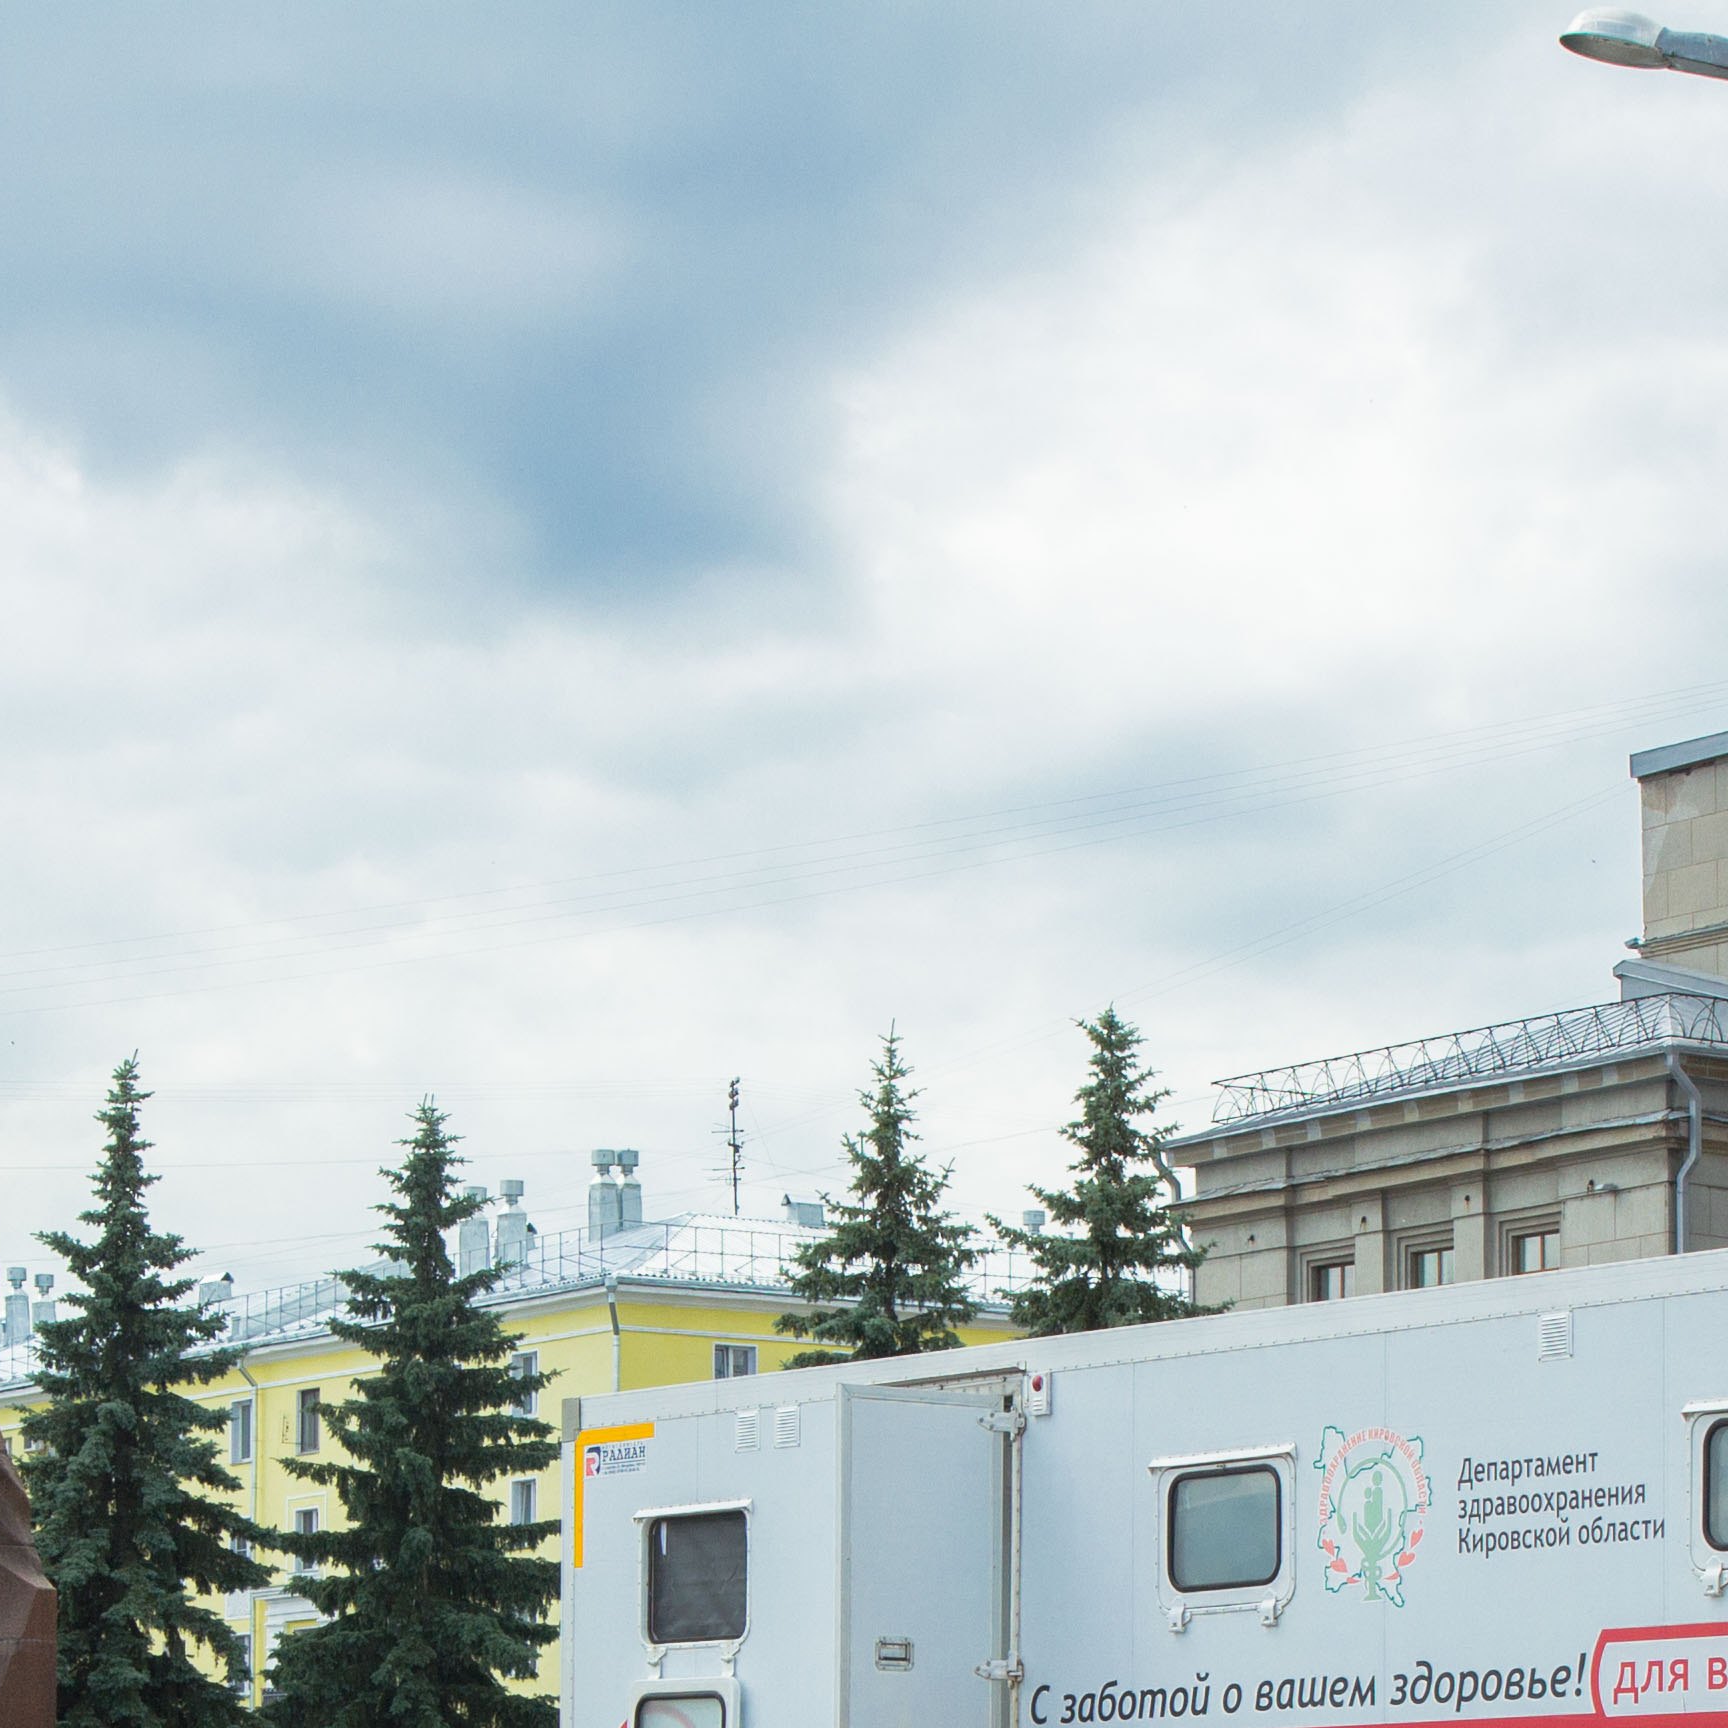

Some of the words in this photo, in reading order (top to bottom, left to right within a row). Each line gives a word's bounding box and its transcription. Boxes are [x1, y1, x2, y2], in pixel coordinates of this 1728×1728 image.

[1457, 1451, 1599, 1491] Департамент
[1458, 1483, 1646, 1524] здравоохранения
[1458, 1517, 1570, 1559] Кировской
[1578, 1515, 1665, 1545] области
[1030, 1684, 1051, 1724] С
[1061, 1672, 1210, 1723] заботой
[1221, 1684, 1242, 1714] о
[1254, 1675, 1377, 1712] вашем
[1390, 1652, 1586, 1713] здоровье!
[1613, 1658, 1689, 1705] для
